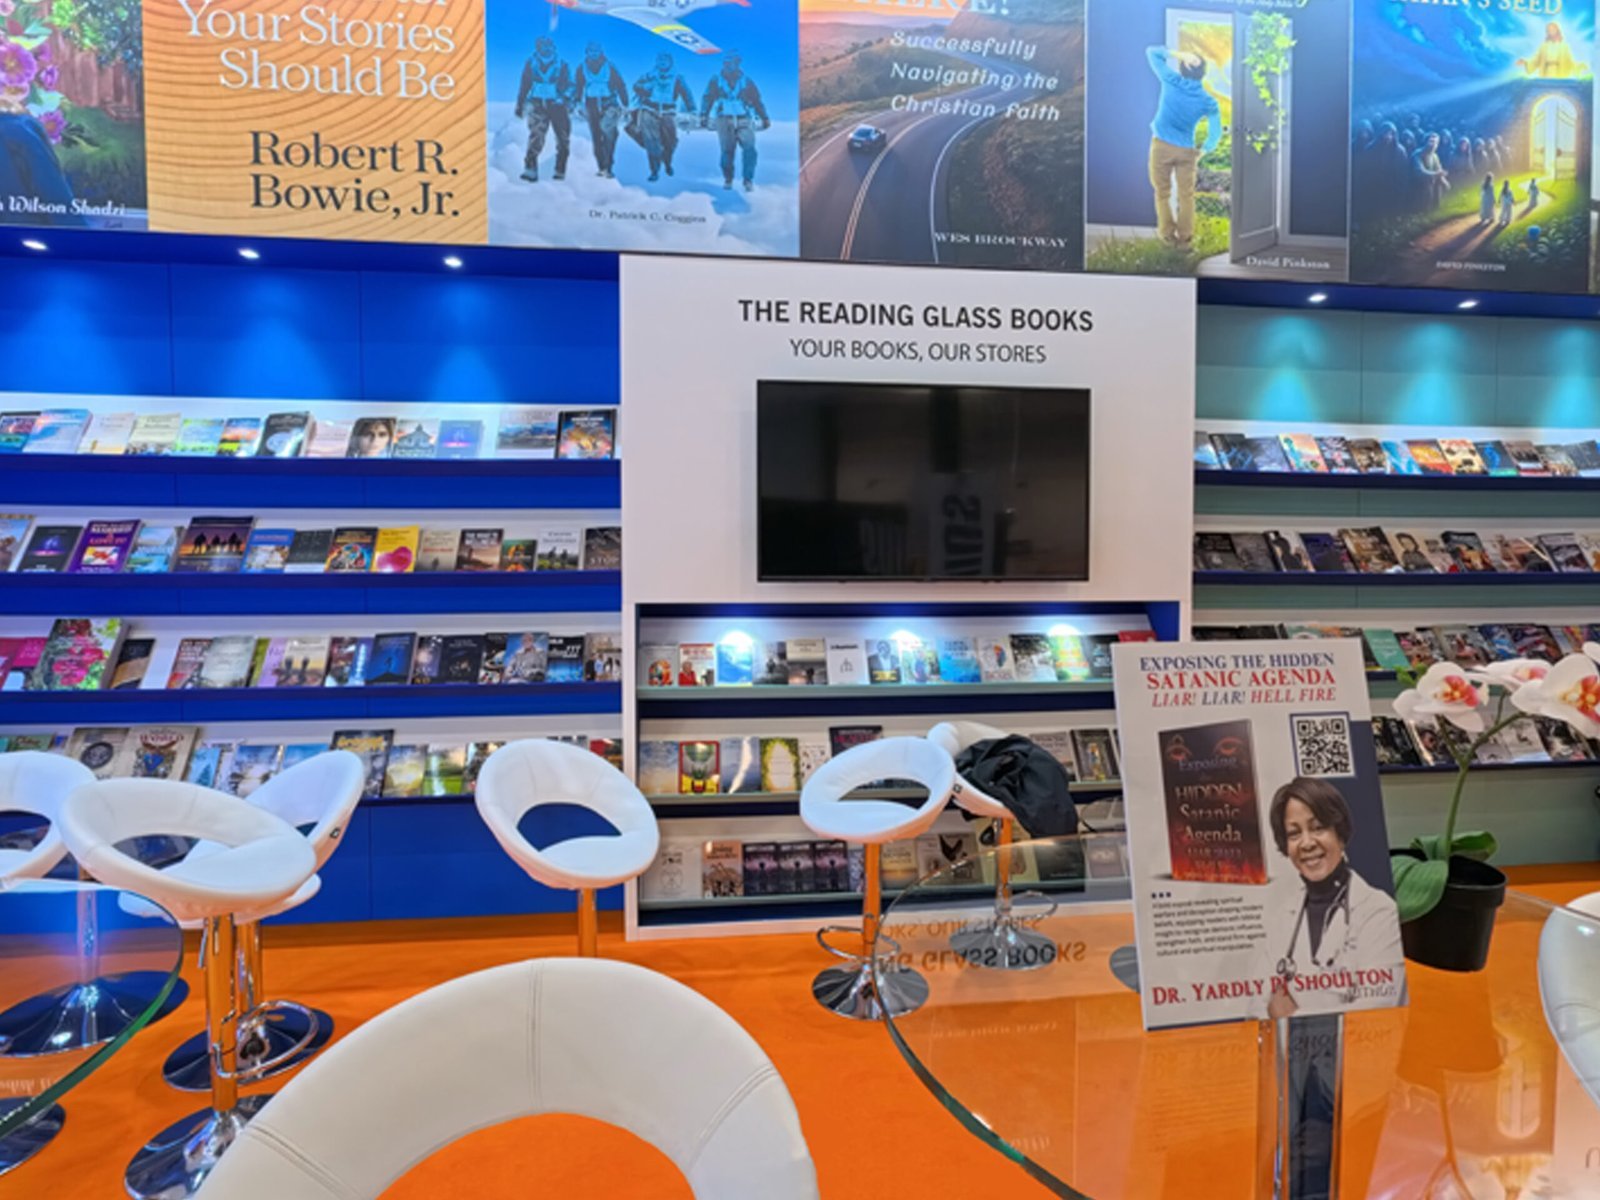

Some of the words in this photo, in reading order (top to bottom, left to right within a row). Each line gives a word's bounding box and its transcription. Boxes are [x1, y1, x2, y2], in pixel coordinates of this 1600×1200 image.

[181, 0, 290, 41] Your
[300, 4, 455, 53] Stories
[890, 30, 1038, 61] Successfully
[219, 47, 383, 96] Should
[396, 59, 455, 100] Be
[890, 62, 1016, 92] Navigating
[1022, 72, 1059, 92] the
[890, 94, 998, 120] Christian
[249, 131, 403, 173] Robert
[414, 139, 458, 175] R.
[9, 195, 67, 214] Wilson
[69, 198, 126, 216] Shadzi
[250, 173, 402, 219] Bowie,
[410, 183, 460, 217] Jr.
[588, 209, 604, 219] Dr.
[609, 210, 647, 220] Patrick
[934, 231, 970, 244] WES
[974, 233, 1068, 247] BROCKWAY
[1246, 256, 1279, 267] David
[738, 299, 790, 323] THE
[799, 301, 914, 327] READING
[923, 304, 1001, 329] GLASS
[1010, 307, 1093, 332] BOOKS
[790, 338, 846, 358] YOUR
[851, 340, 923, 362] BOOKS,
[928, 343, 971, 362] OUR
[975, 344, 1047, 363] STORES
[1140, 654, 1227, 671] EXPOSING
[1231, 654, 1266, 668] THE
[1270, 653, 1335, 667] HIDDEN
[1147, 670, 1242, 690] SATANIC
[1247, 668, 1336, 687] AGENDA
[1151, 691, 1197, 707] LIAR!
[1201, 690, 1246, 706] LIAR!
[1250, 689, 1295, 704] HELL
[1299, 687, 1337, 702] FIRE
[1175, 783, 1242, 799] HIDDEN
[1180, 804, 1240, 819] Satanic
[1185, 823, 1242, 843] Agenda
[1152, 986, 1186, 1005] DR.
[1192, 978, 1264, 1004] YARDLY
[1294, 968, 1394, 993] SHOULTON
